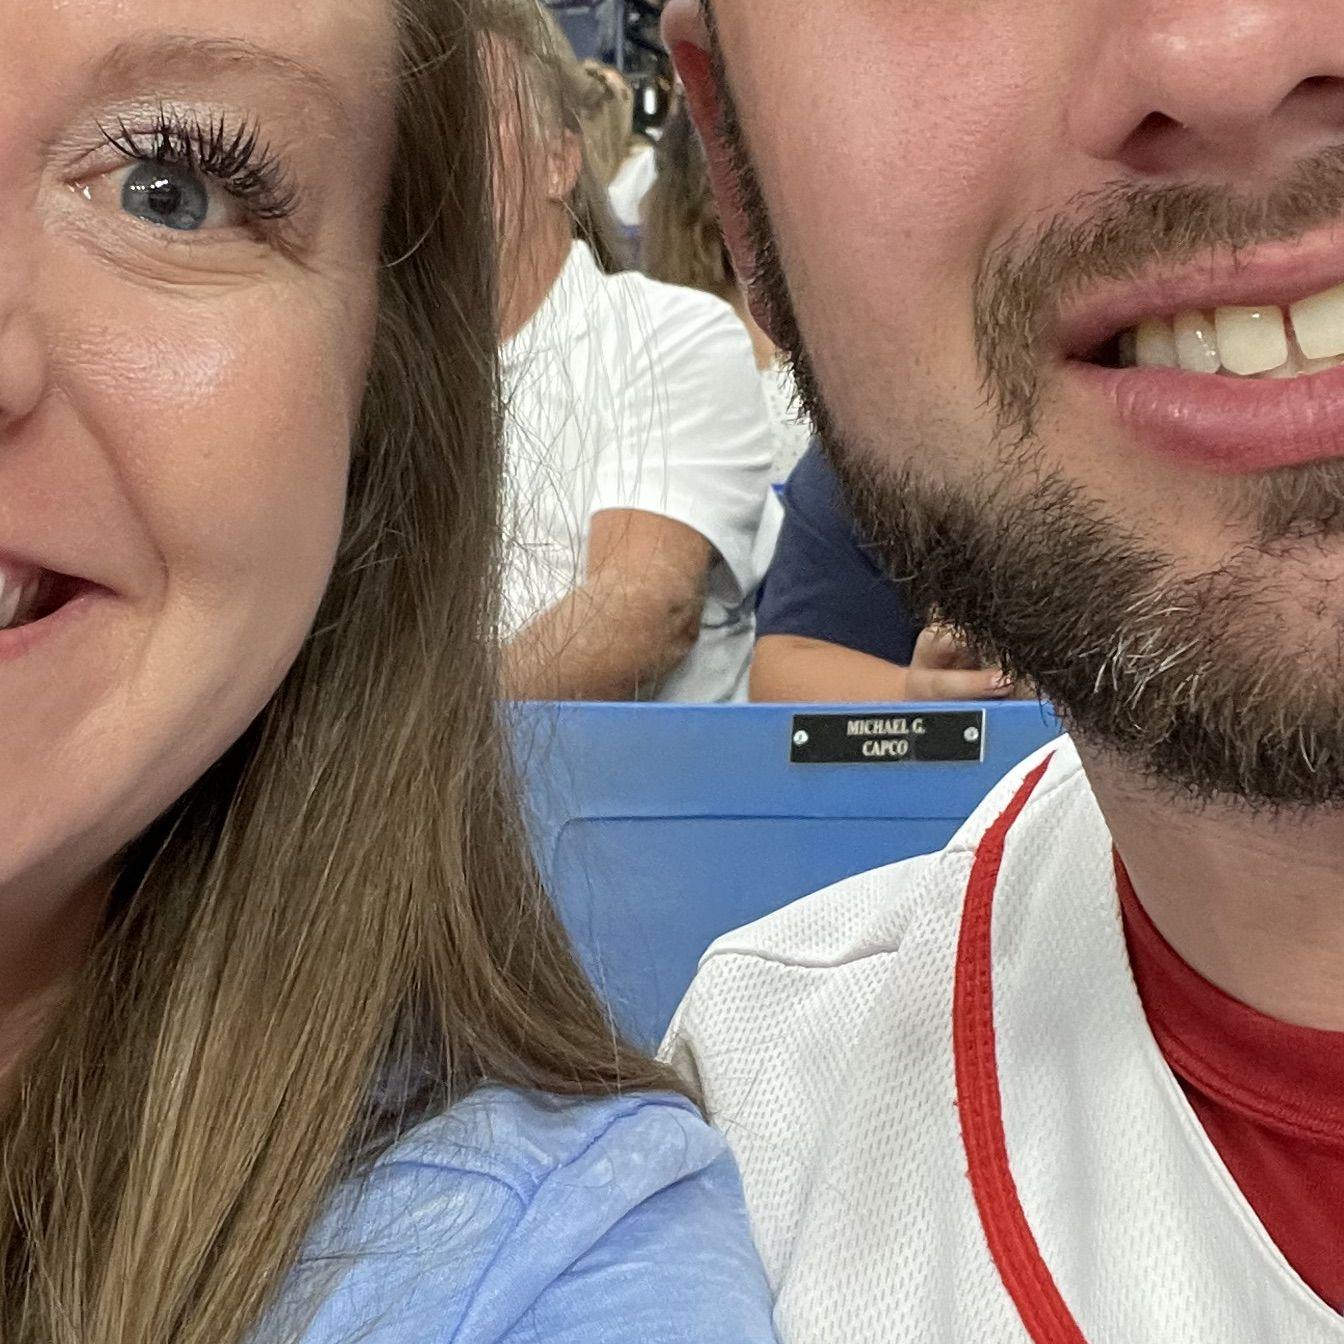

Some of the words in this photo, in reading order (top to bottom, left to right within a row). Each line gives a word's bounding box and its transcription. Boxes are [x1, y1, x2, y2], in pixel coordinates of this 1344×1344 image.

[847, 718, 909, 735] MICHAEL
[912, 718, 926, 734] G.
[862, 739, 909, 756] CAPCO
